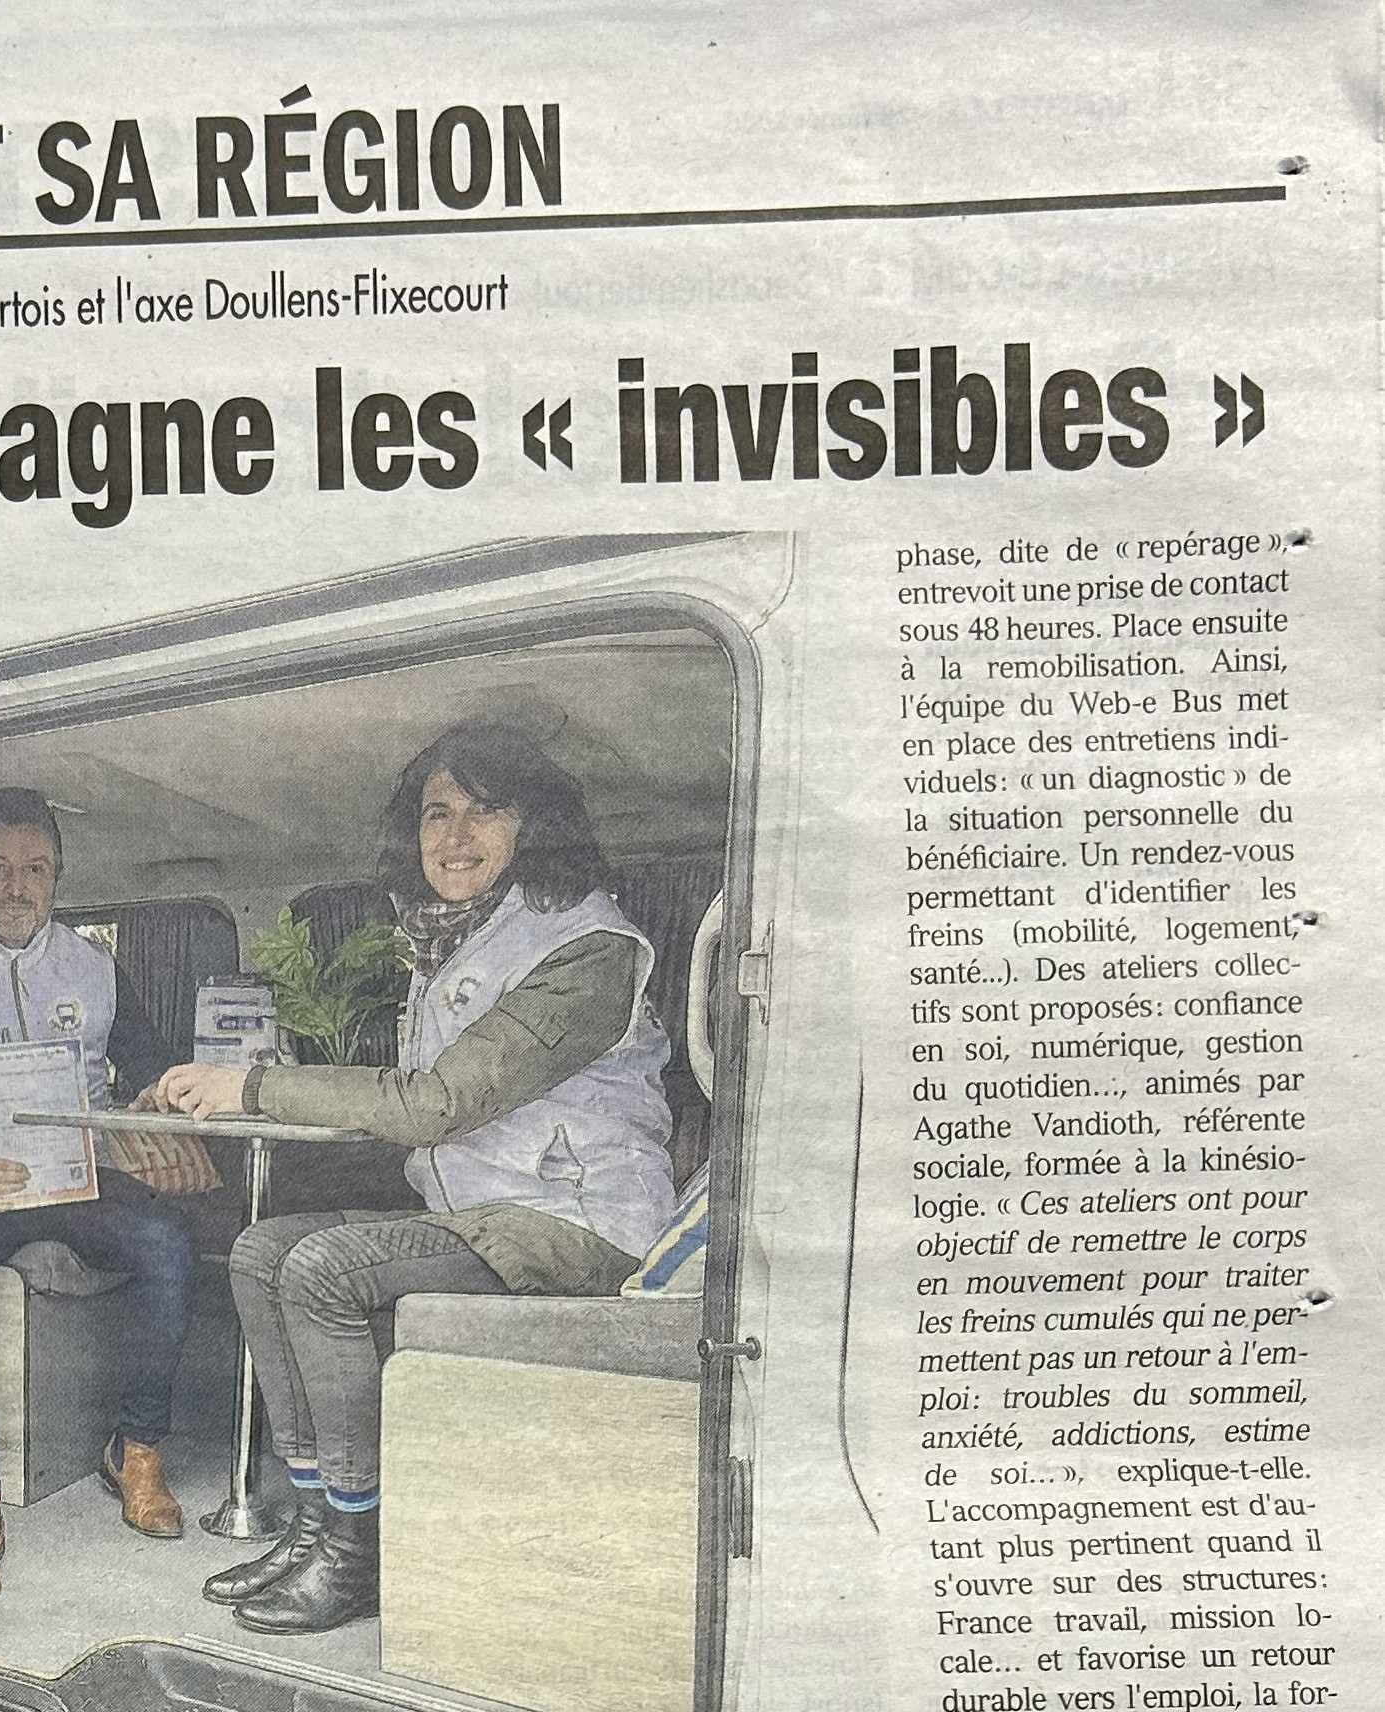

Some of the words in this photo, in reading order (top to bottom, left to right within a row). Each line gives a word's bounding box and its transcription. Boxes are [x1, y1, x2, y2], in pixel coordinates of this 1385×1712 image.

[34, 118, 162, 226] SA
[195, 83, 563, 219] RÉGION
[77, 288, 106, 326] et
[116, 275, 194, 324] l'axe
[205, 267, 509, 321] Doullens-Flixecourt
[315, 366, 479, 492] les
[617, 341, 1170, 484] invisibles
